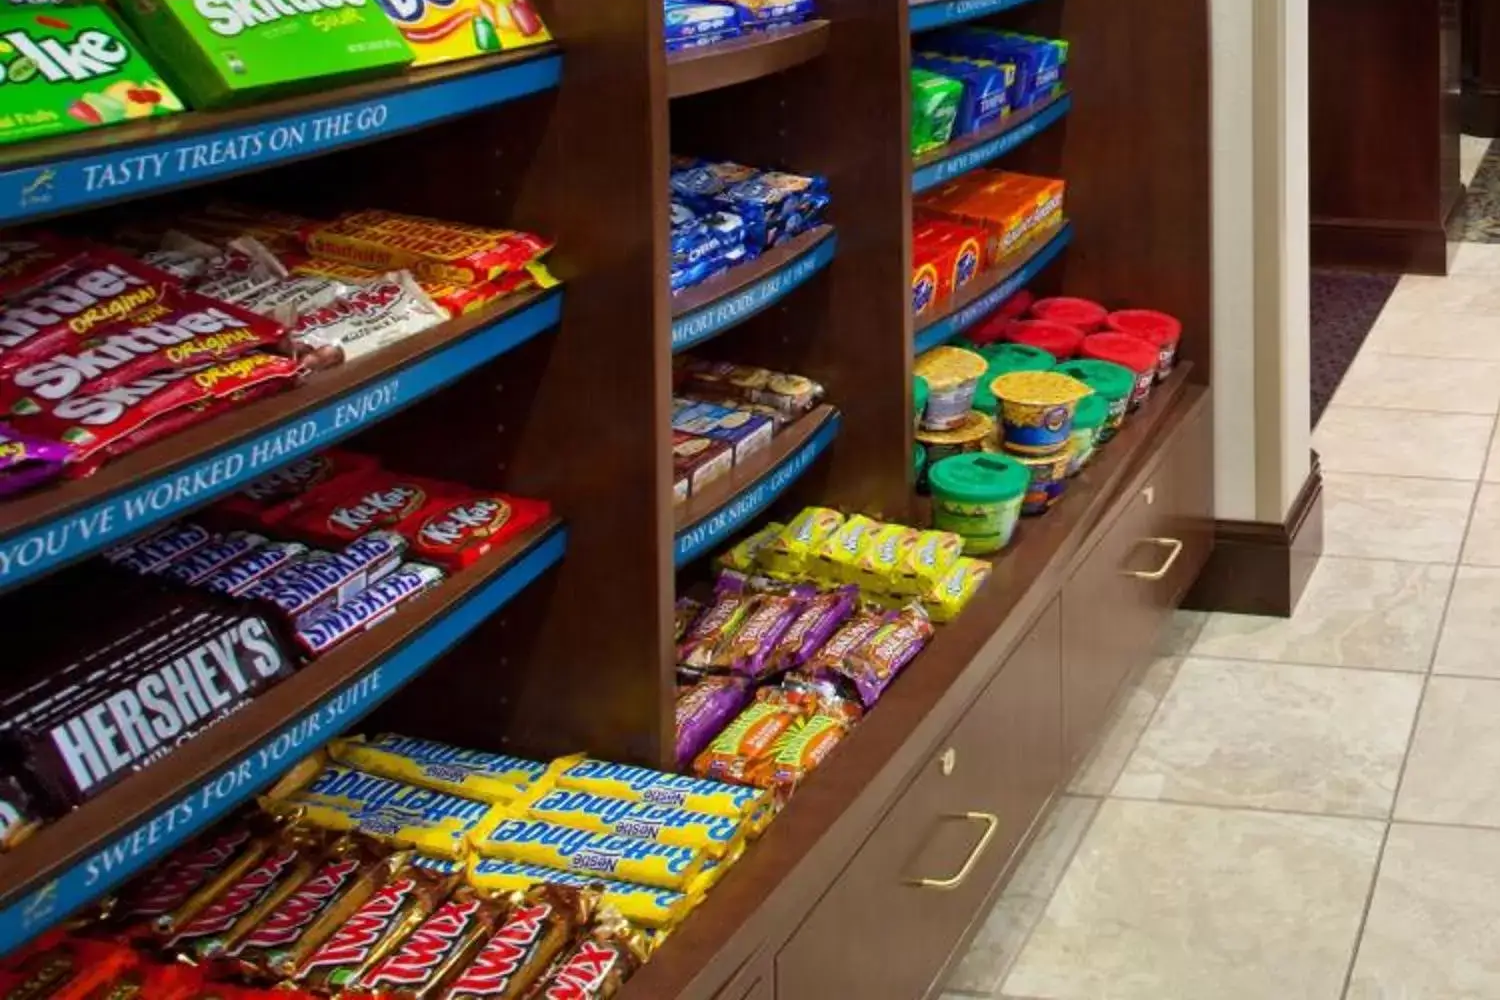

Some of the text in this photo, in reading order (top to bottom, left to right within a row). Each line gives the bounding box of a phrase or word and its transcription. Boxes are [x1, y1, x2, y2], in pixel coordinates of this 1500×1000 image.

[83, 104, 387, 191] TASTY TREATS ON THE GO
[0, 505, 115, 575] YOU'VE
[123, 453, 243, 521] WORKED
[274, 533, 391, 609] SNICKERS
[306, 566, 423, 649] SNICKERS
[51, 616, 282, 792] HERSHEY'S
[84, 668, 384, 886] SWEETS FOR YOUR SUITE
[223, 860, 360, 958] TWIX
[293, 878, 416, 980] TWIX
[360, 899, 481, 988] TWIX
[446, 903, 552, 1000] TWIX
[546, 942, 618, 1000] WIX
